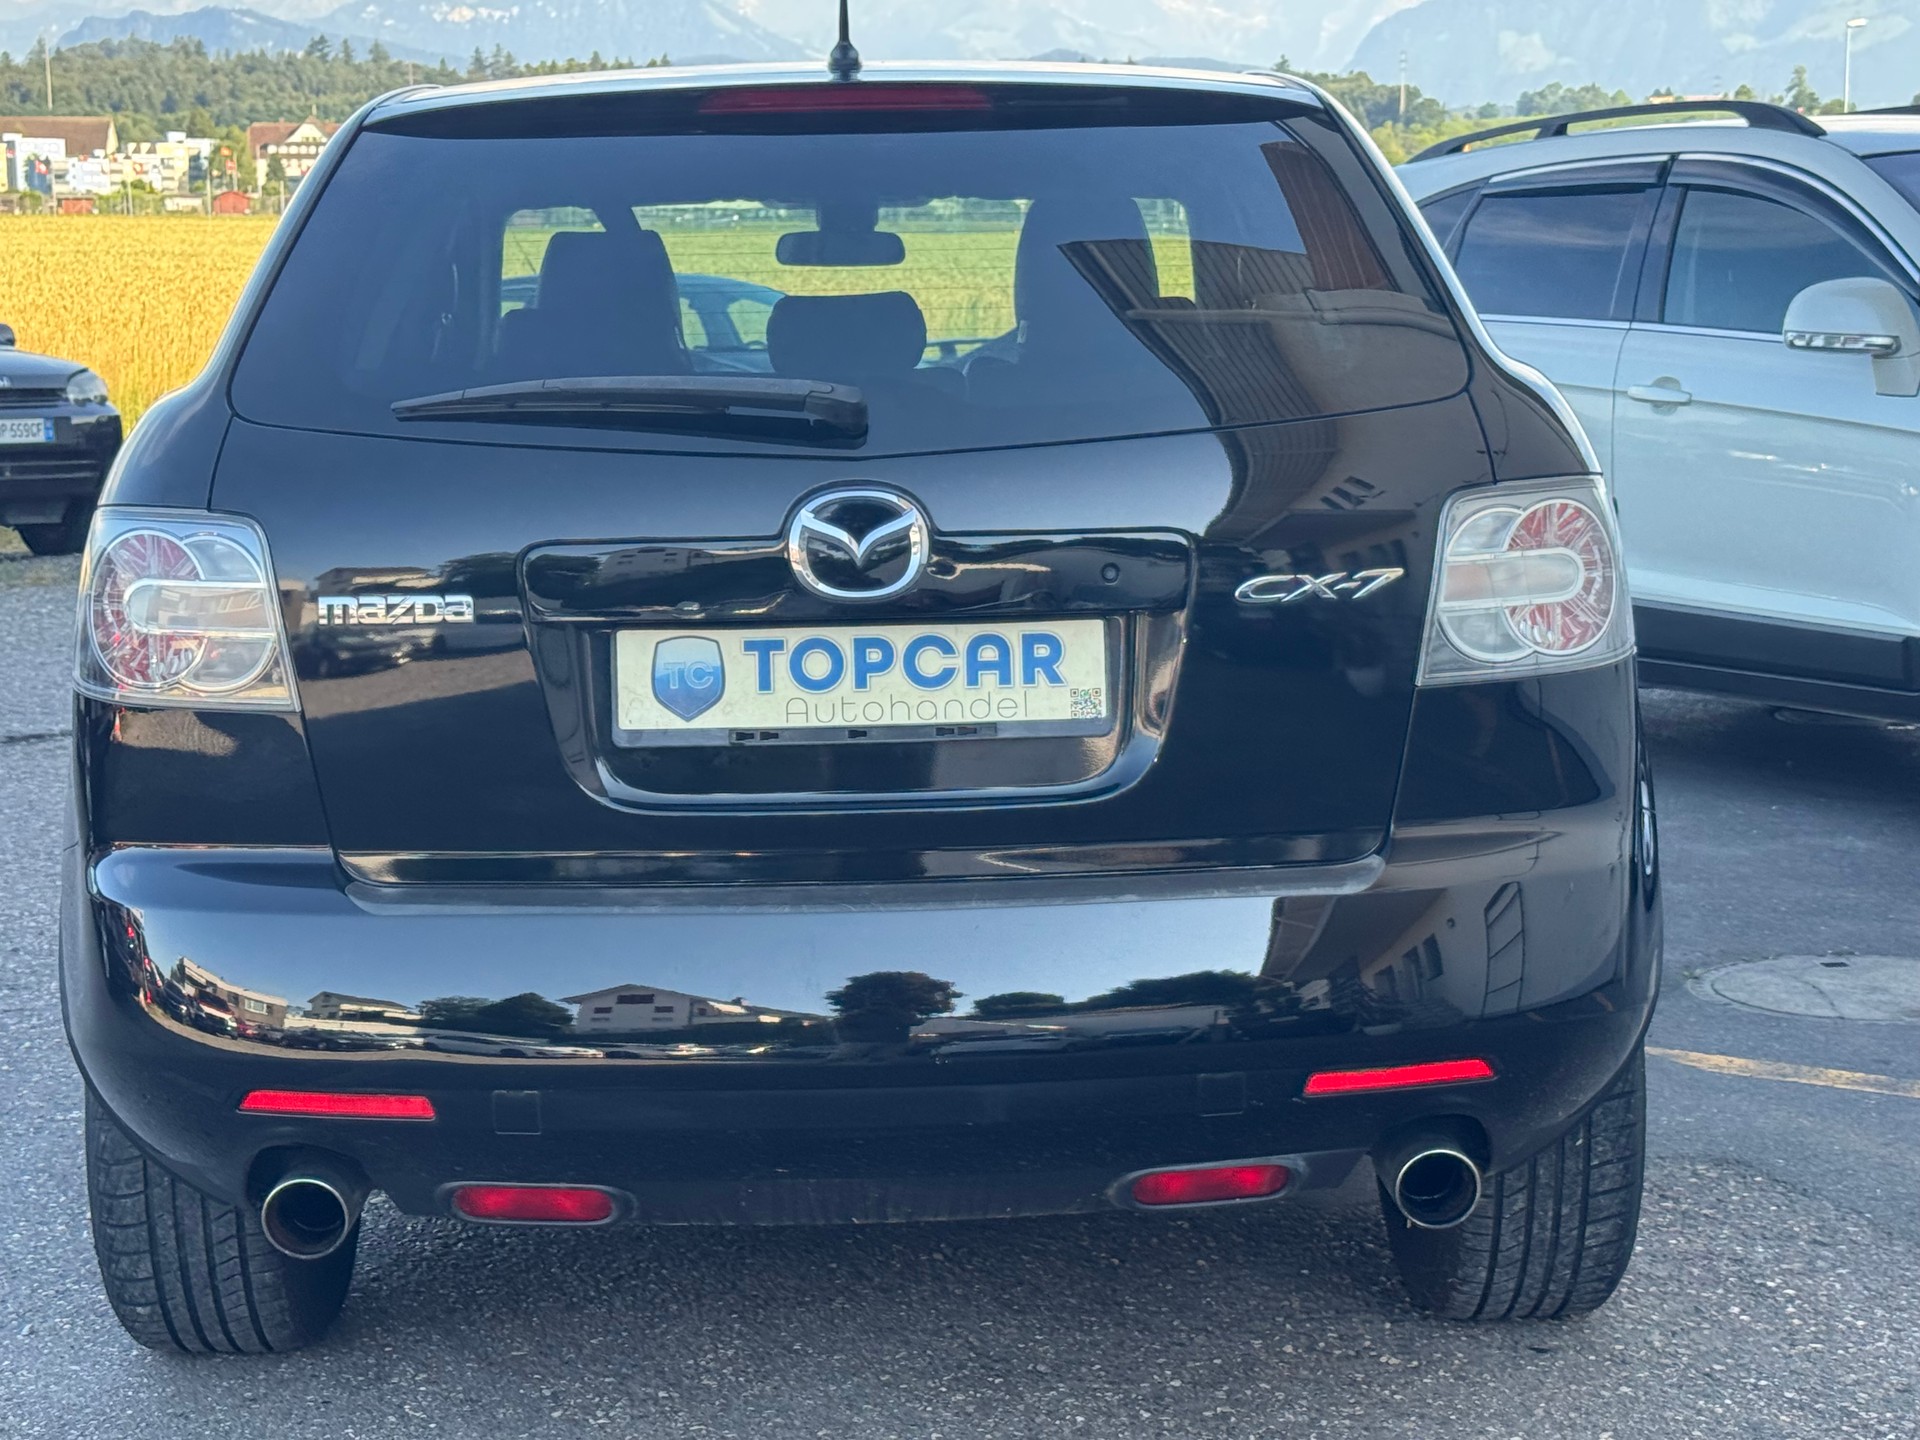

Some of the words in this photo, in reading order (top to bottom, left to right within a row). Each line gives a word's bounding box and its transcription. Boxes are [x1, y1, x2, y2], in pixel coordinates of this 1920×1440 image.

[1234, 567, 1404, 603] CX-7
[663, 661, 714, 690] TC
[741, 631, 1067, 693] TOPCAR
[785, 691, 1029, 723] Autohandel
